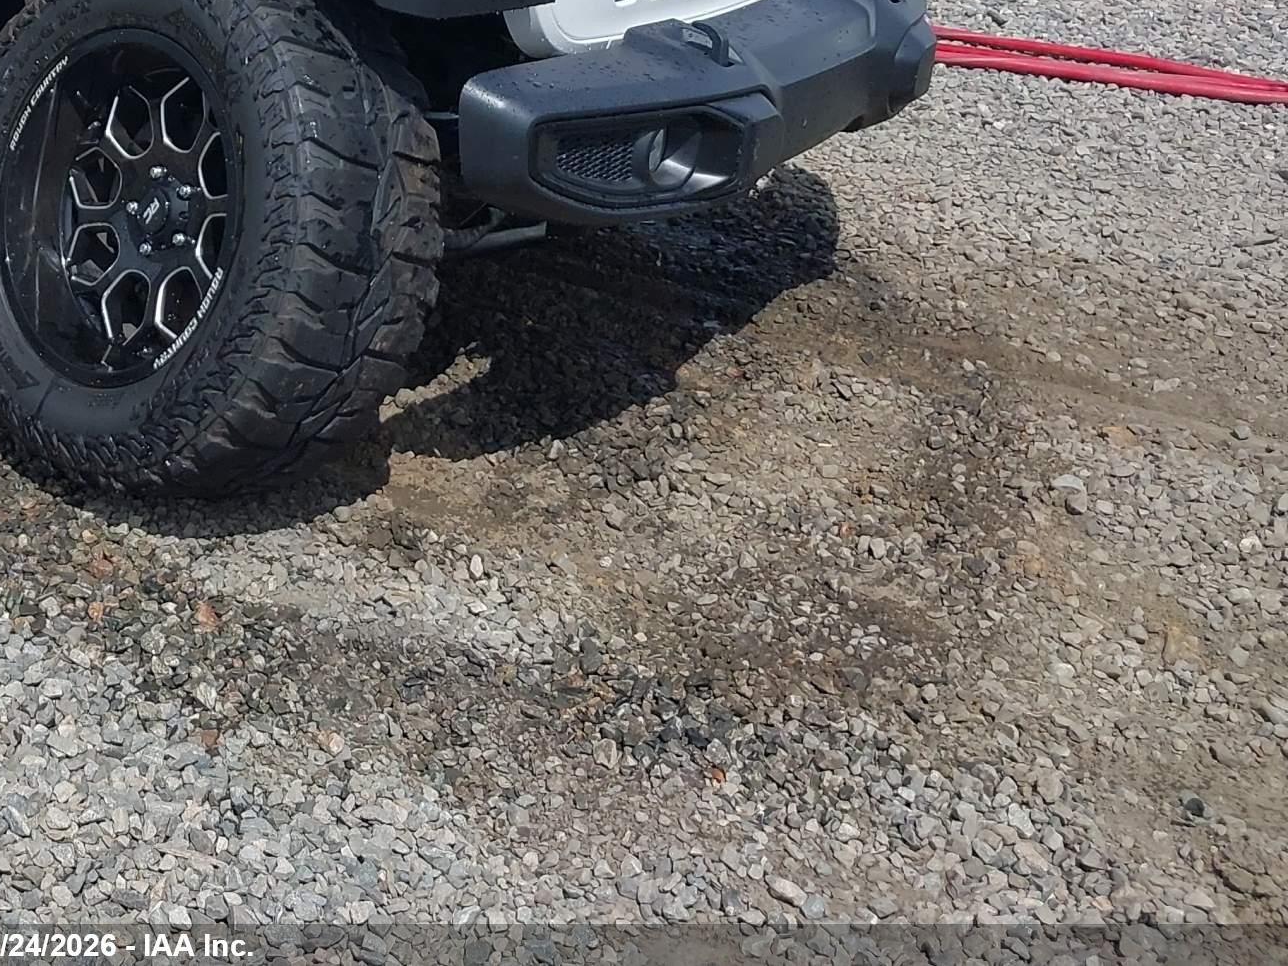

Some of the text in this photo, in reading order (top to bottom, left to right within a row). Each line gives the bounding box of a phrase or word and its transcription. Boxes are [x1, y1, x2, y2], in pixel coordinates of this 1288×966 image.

[9, 105, 32, 151] ROUGH
[30, 55, 69, 107] COUNTRY
[152, 266, 224, 370] ROUGH COUNTRY
